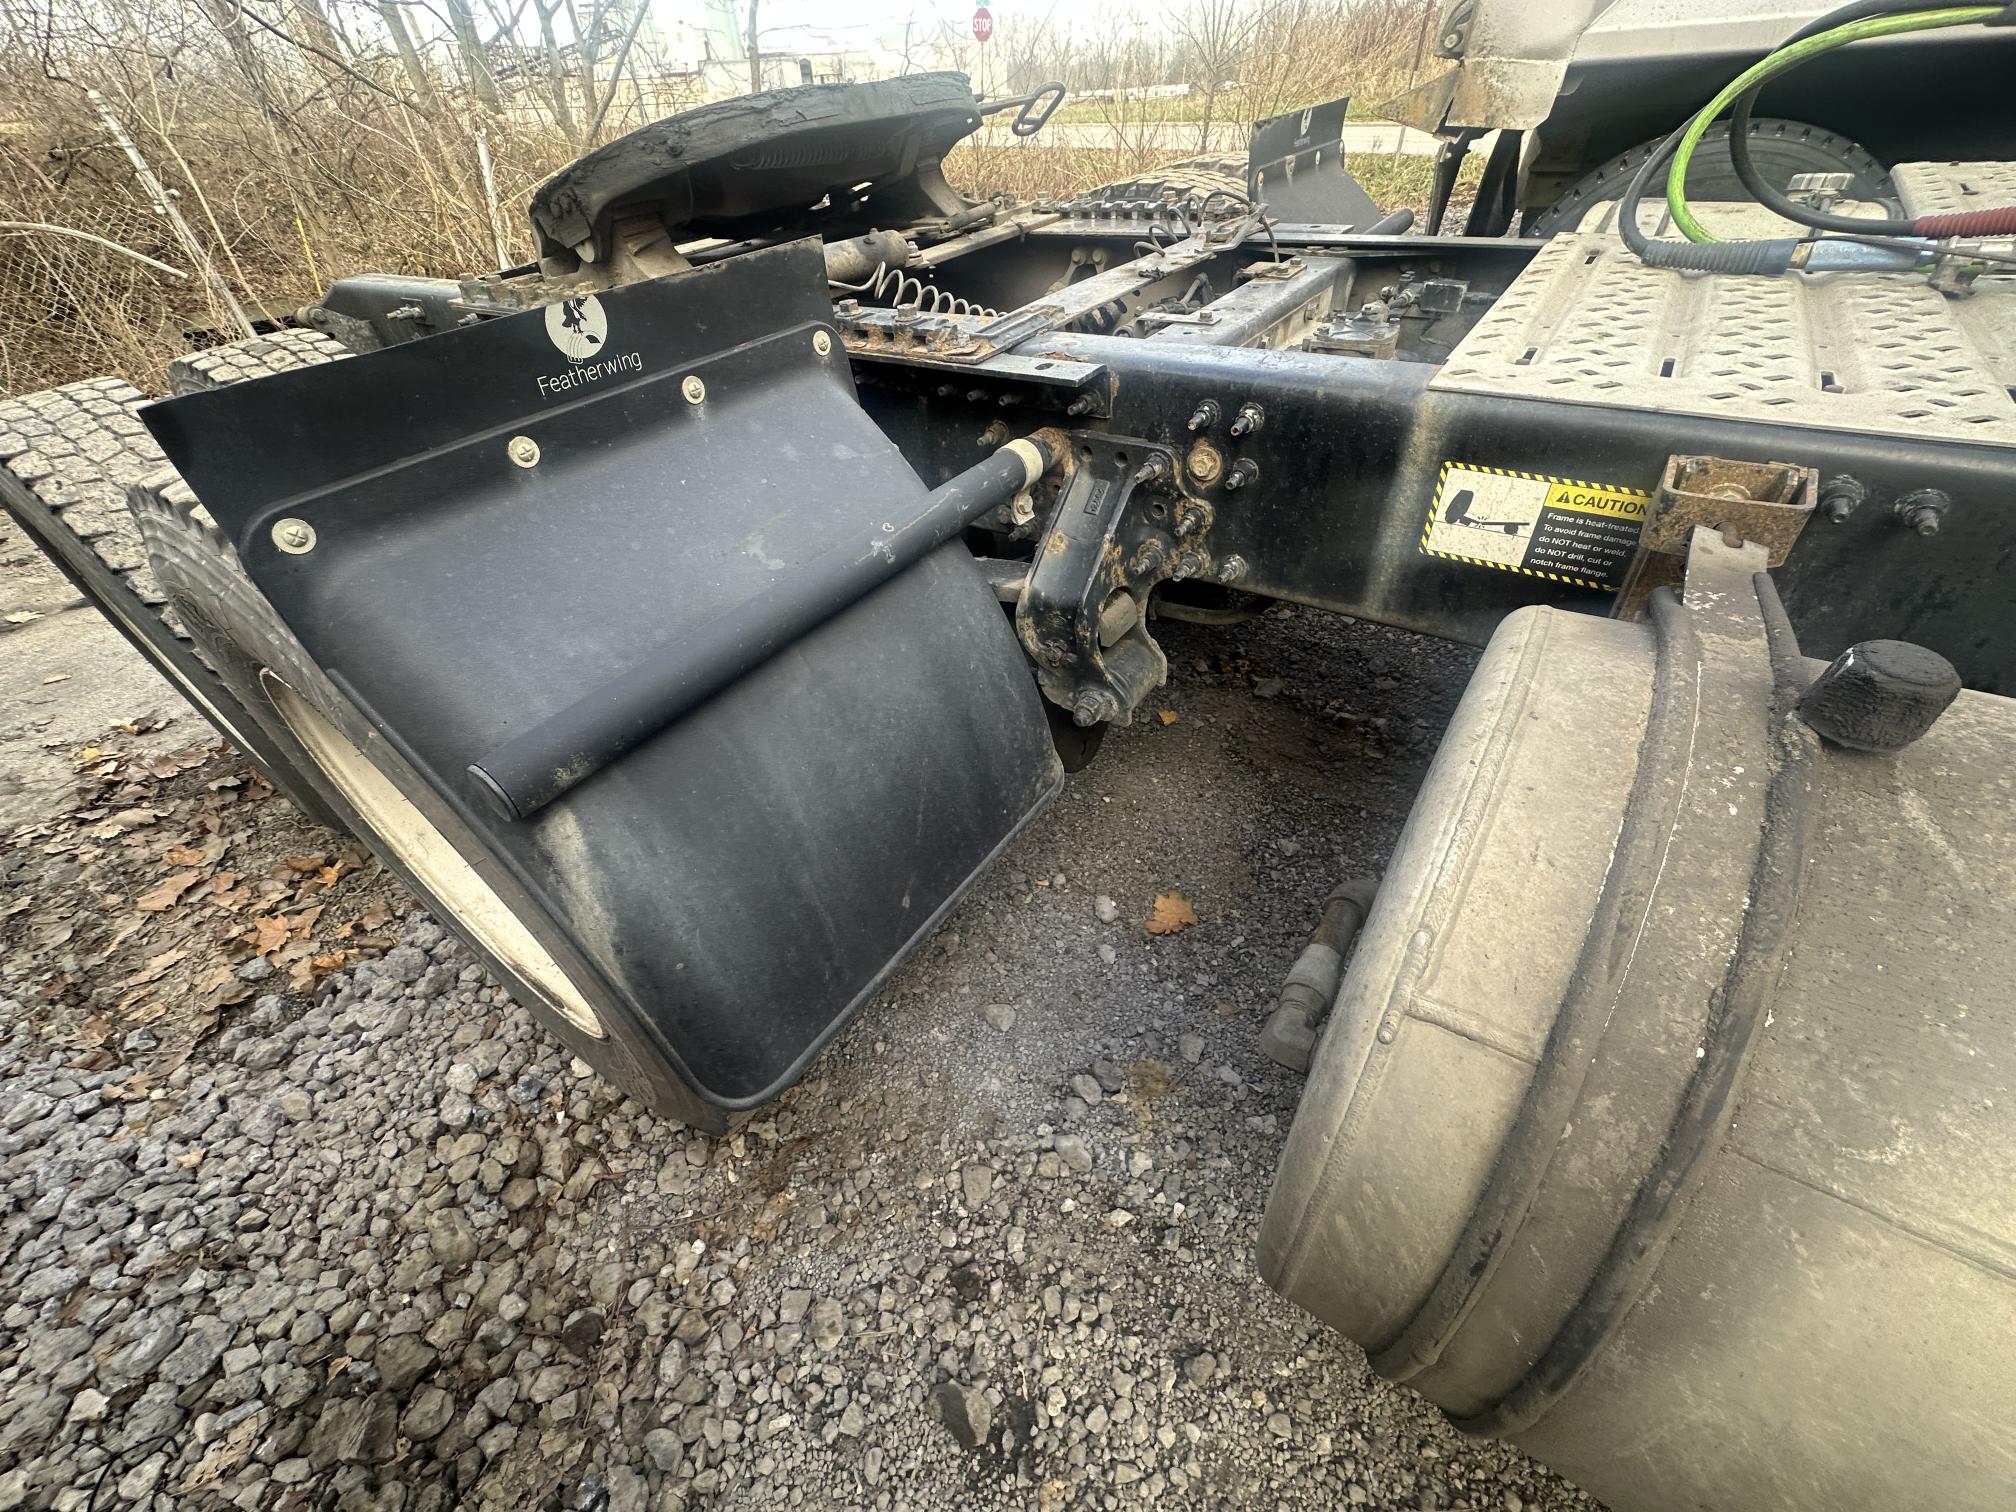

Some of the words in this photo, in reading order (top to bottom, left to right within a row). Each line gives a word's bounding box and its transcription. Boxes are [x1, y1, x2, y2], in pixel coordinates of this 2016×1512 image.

[973, 18, 991, 33] STOP
[536, 351, 643, 396] Featherwing
[1547, 512, 1575, 523] Frame
[1575, 516, 1584, 525] is
[1544, 523, 1553, 532] To
[1554, 526, 1578, 536] avoid
[1577, 529, 1602, 540] frame
[1534, 546, 1546, 554] do
[1547, 548, 1567, 558] NOT
[1587, 557, 1602, 565] cut
[1538, 535, 1551, 543] do
[1551, 537, 1572, 546] NOT
[1572, 541, 1592, 550] heat
[1604, 548, 1627, 558] weld.
[1530, 558, 1554, 568] notch
[1554, 561, 1580, 572] frame
[1580, 566, 1609, 578] flange.
